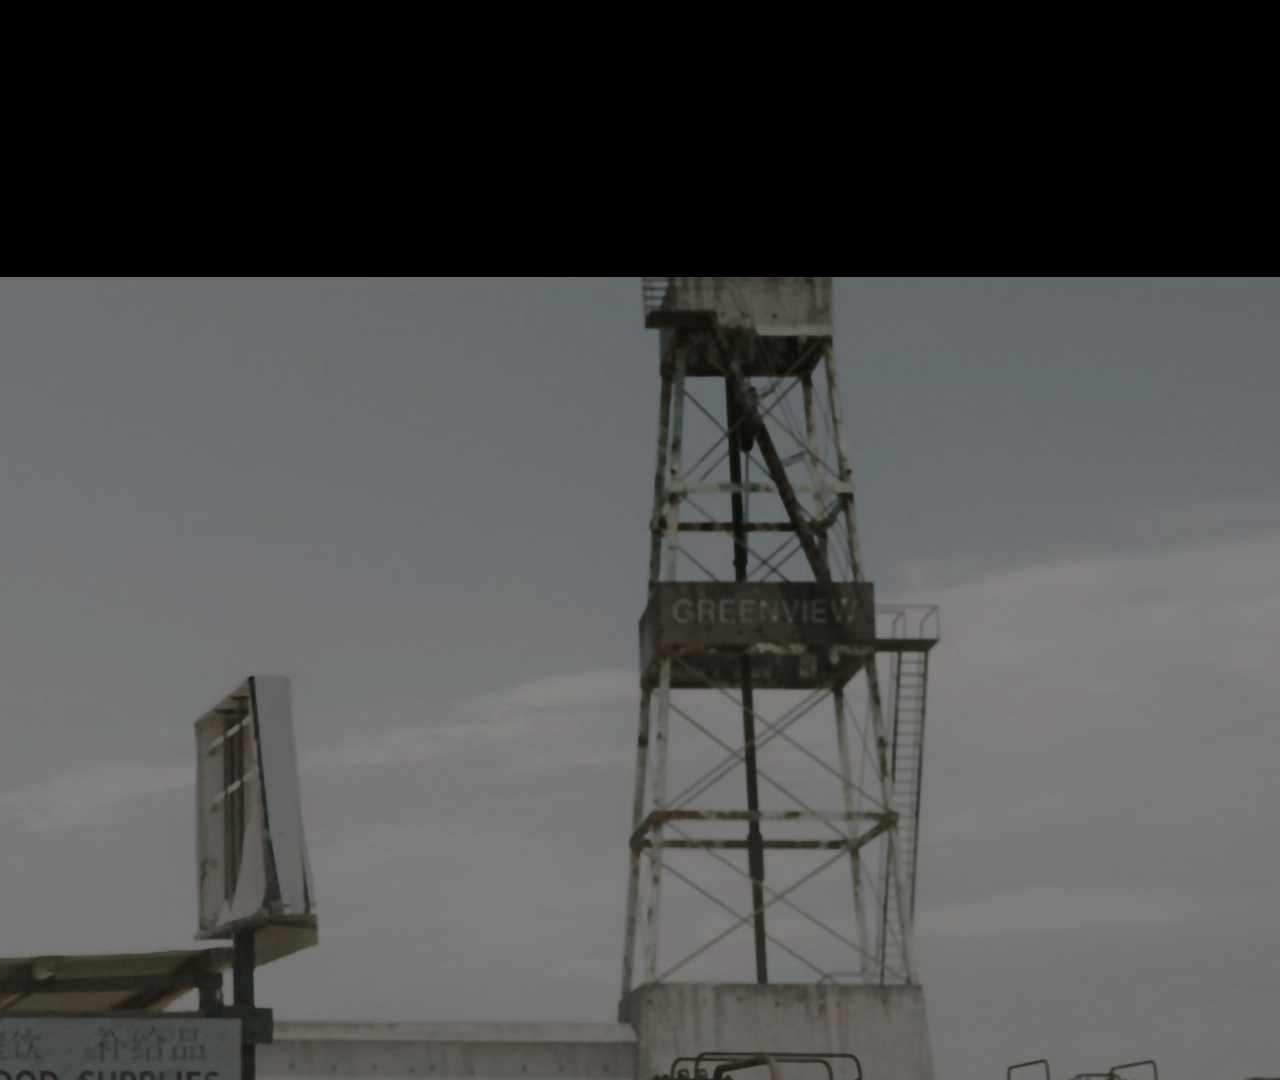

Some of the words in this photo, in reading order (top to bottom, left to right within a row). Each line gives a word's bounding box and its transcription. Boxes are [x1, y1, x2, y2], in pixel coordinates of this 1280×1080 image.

[671, 597, 858, 624] GREENVIEW
[96, 1025, 207, 1062] 补给品
